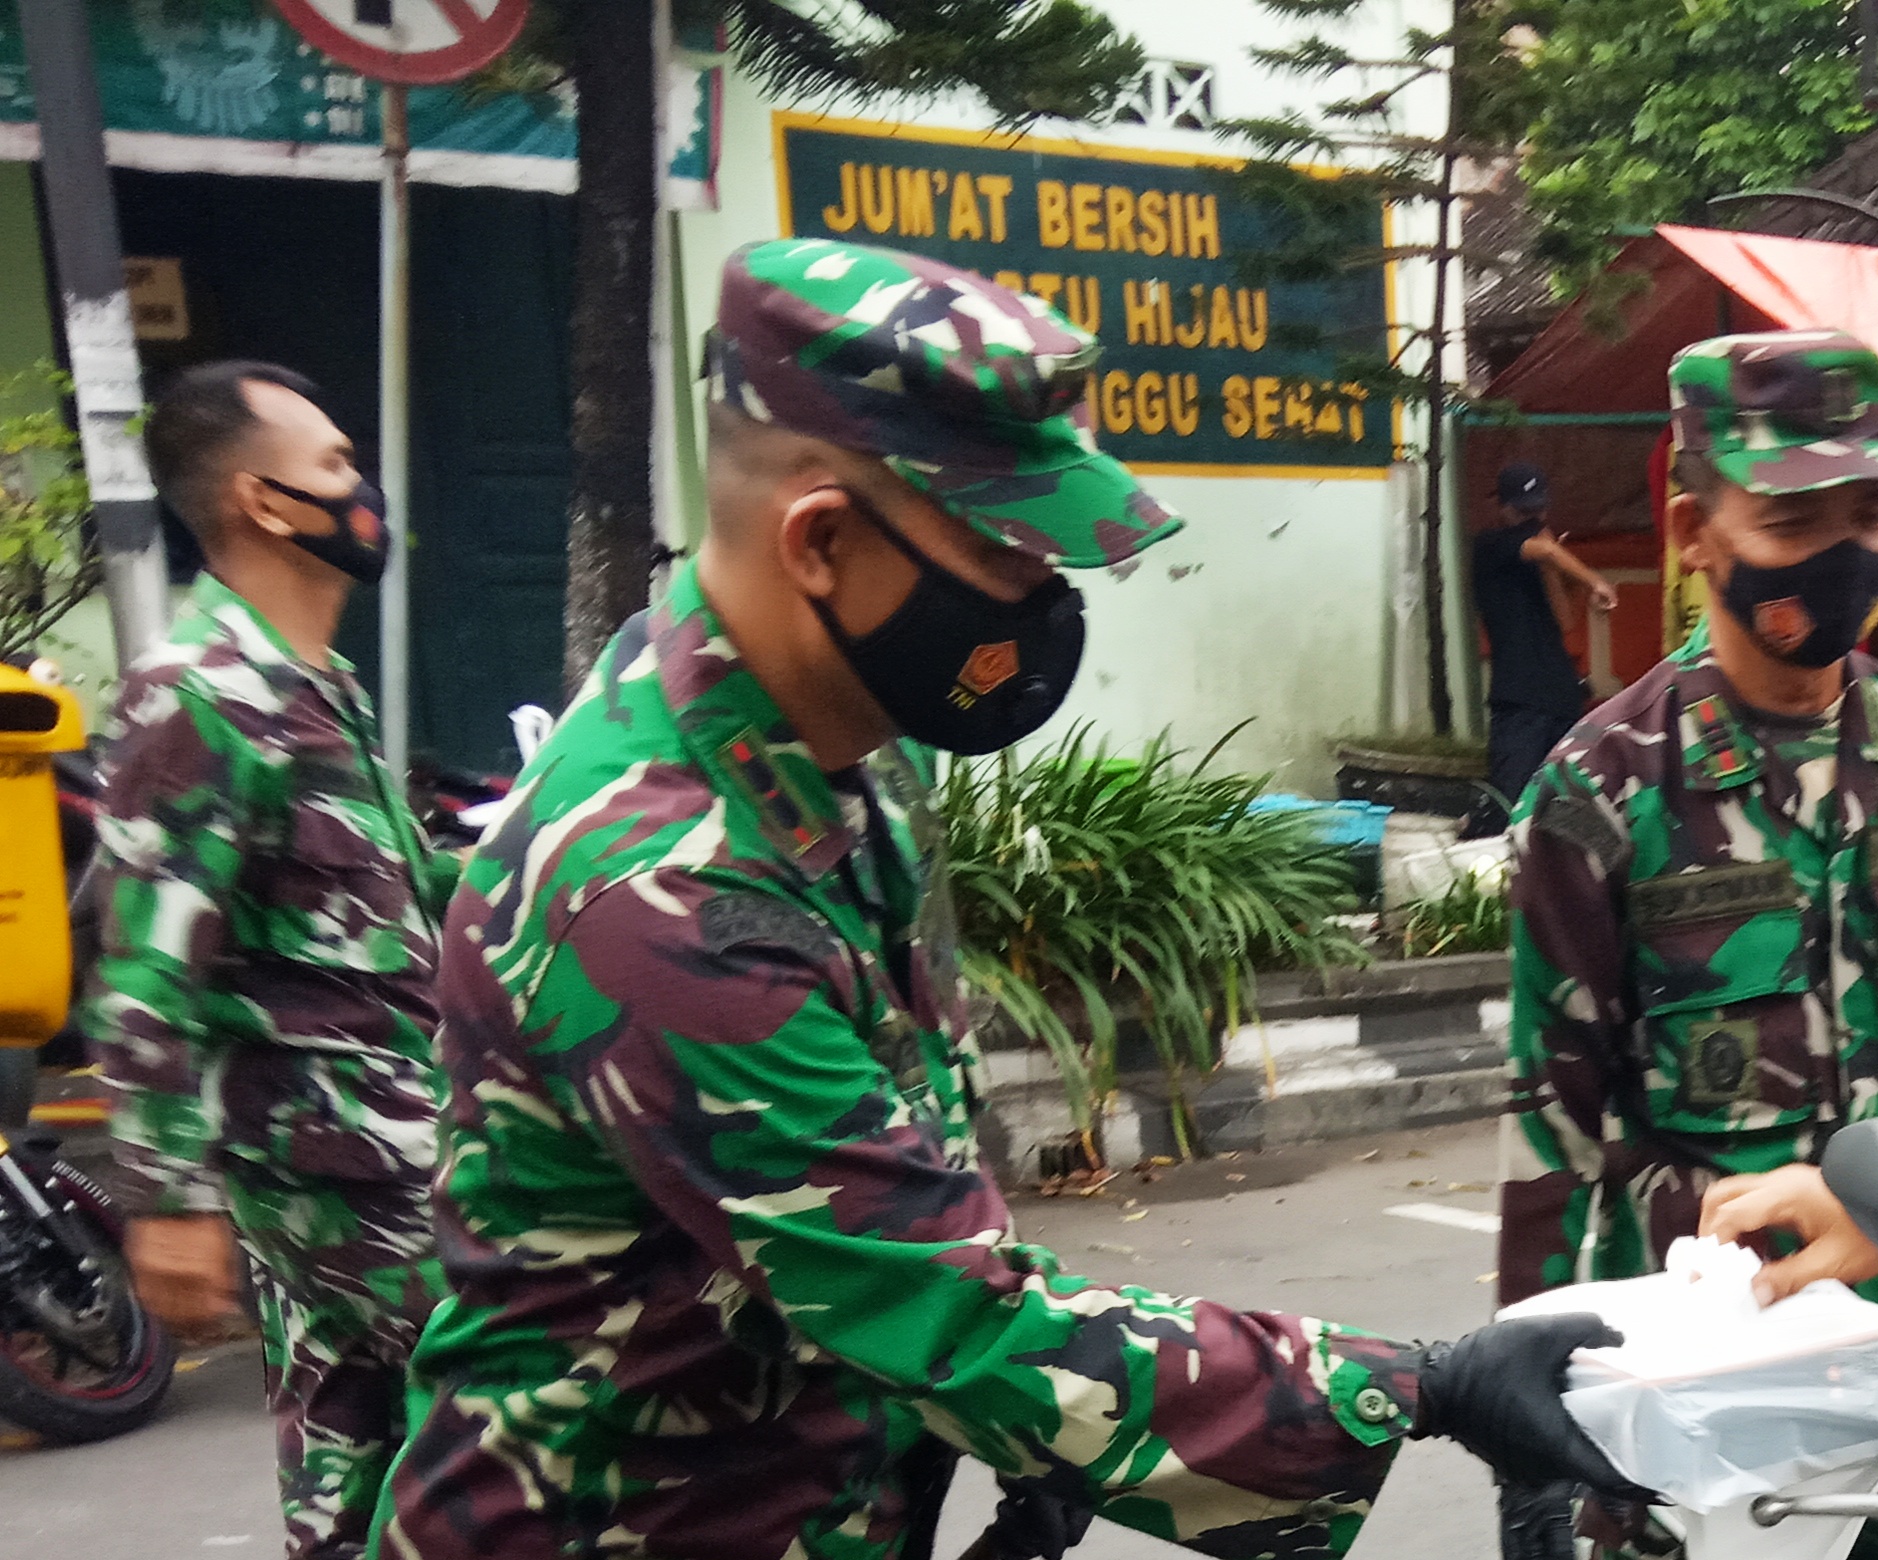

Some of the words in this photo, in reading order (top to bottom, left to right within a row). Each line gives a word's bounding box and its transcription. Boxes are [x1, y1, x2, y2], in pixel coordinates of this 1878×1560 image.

[822, 161, 1013, 244] JUM'AT
[1037, 178, 1222, 261] BERSIH
[1122, 276, 1268, 352] HIJAU
